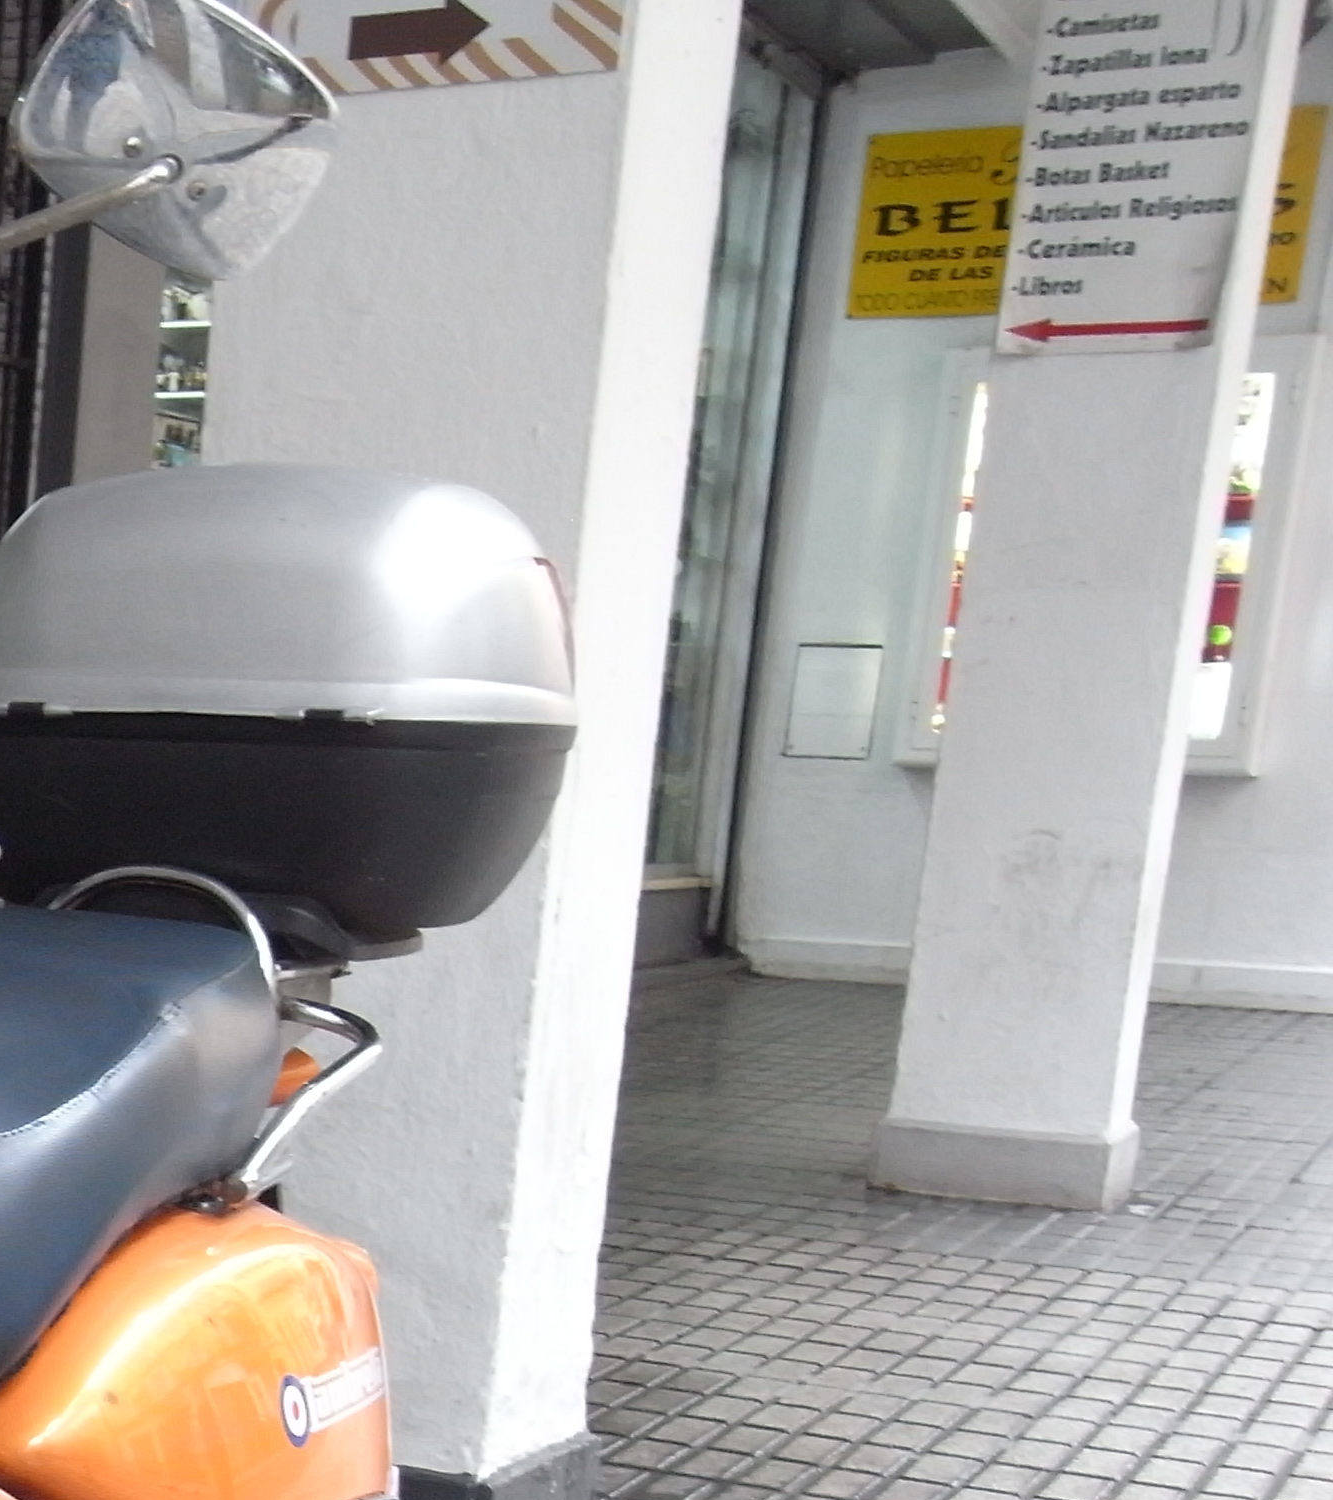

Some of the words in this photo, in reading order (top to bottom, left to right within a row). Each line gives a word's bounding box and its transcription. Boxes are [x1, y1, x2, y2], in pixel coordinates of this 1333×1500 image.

[1159, 81, 1242, 106] esparto
[1145, 120, 1250, 142] Nazareno
[1099, 160, 1170, 183] Basket
[873, 198, 1010, 237] BEL
[908, 268, 941, 281] DE
[948, 266, 993, 280] LAS
